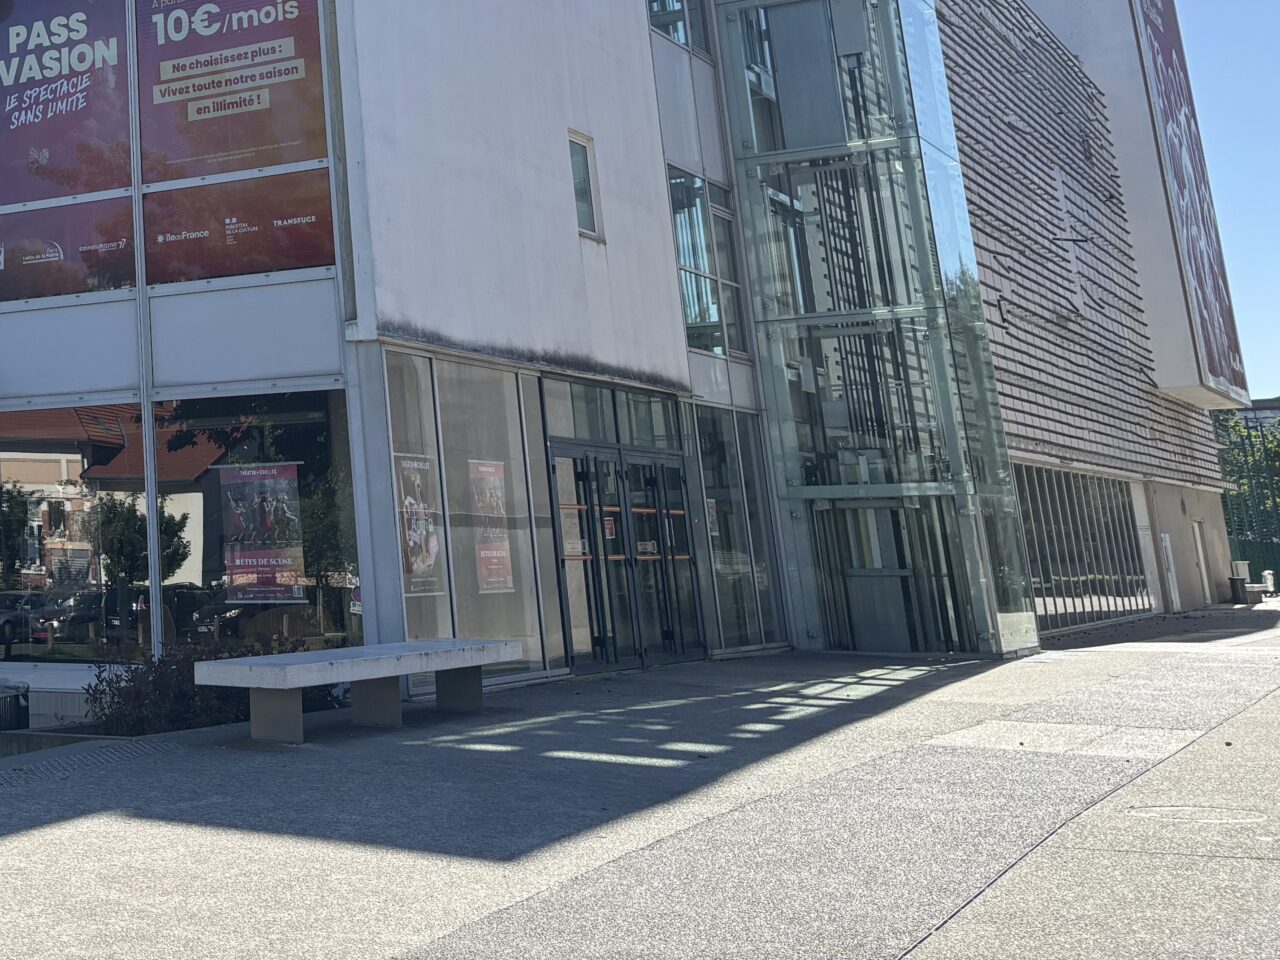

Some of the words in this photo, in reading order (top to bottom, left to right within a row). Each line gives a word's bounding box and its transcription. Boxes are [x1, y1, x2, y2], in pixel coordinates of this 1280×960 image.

[9, 12, 87, 54] PASS
[172, 62, 187, 74] Ne
[188, 51, 249, 70] choisissez
[5, 93, 19, 112] LE
[21, 72, 91, 108] SPECTACLE
[159, 85, 190, 98] Vivez
[192, 79, 222, 93] toute
[225, 73, 257, 87] notre
[259, 65, 299, 80] saison
[9, 104, 44, 130] SANS
[196, 104, 211, 115] en
